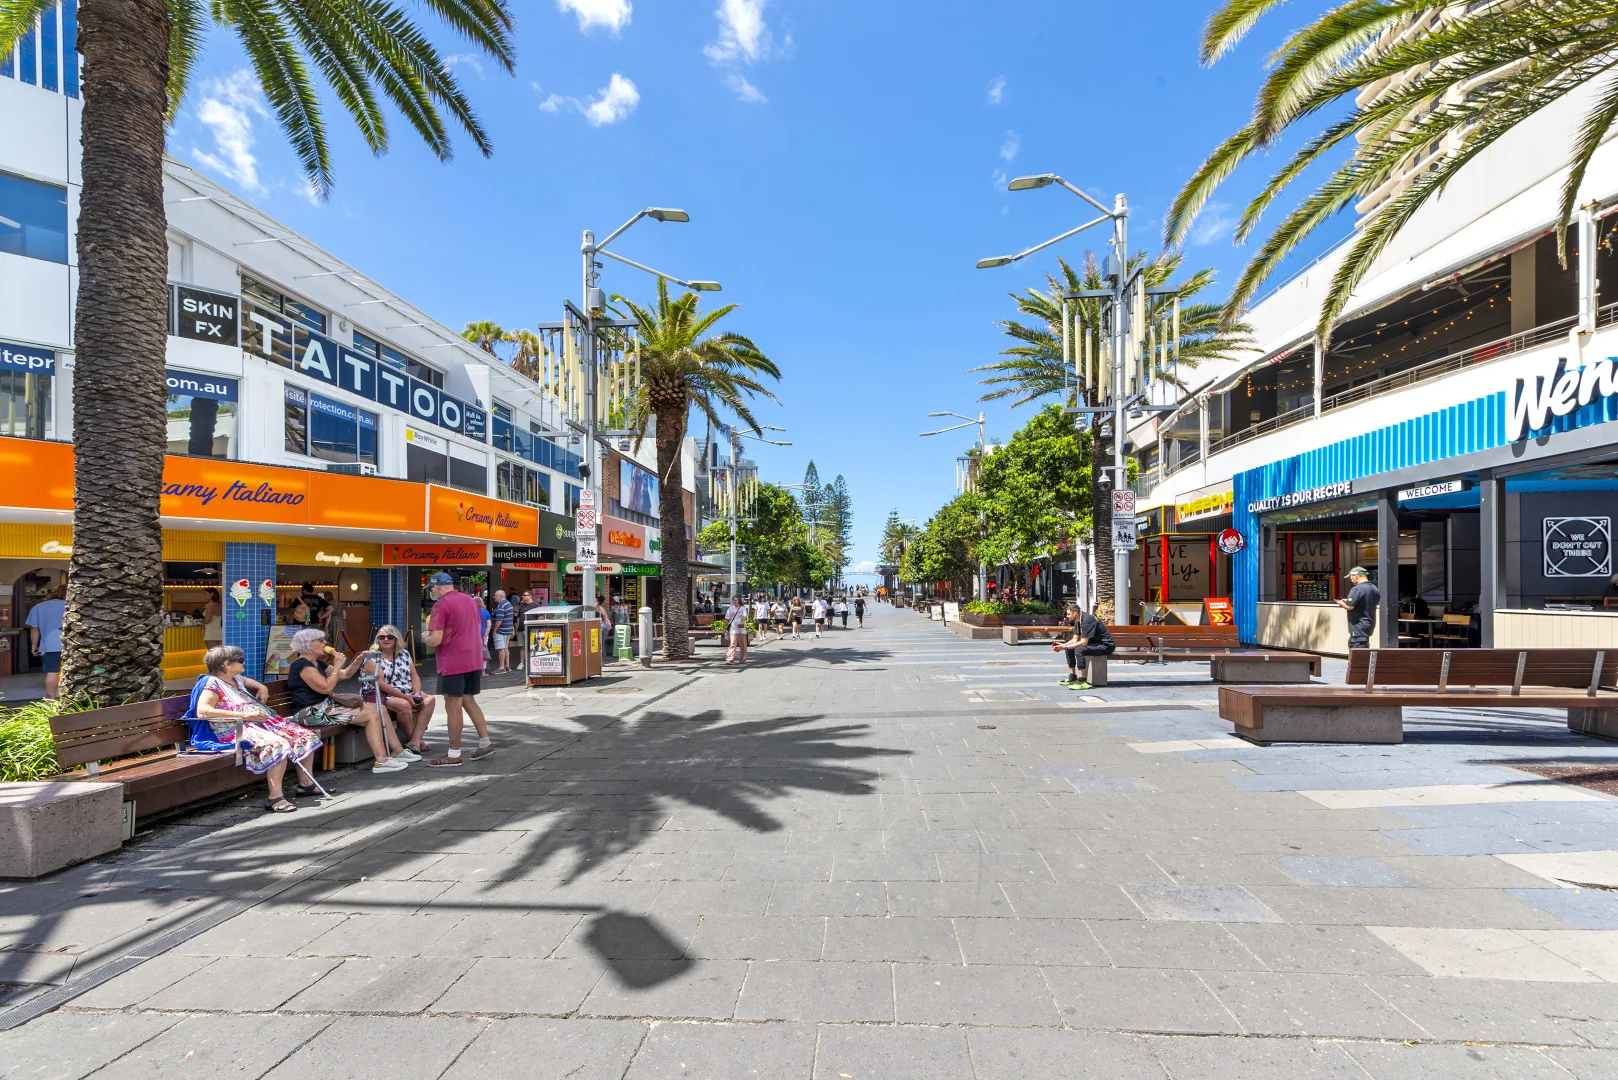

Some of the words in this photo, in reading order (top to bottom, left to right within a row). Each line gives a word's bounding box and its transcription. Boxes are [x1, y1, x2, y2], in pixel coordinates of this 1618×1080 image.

[183, 298, 233, 320] SKIN
[195, 320, 222, 338] FX
[0, 349, 56, 369] tepr
[250, 311, 461, 428] TATTOO
[222, 480, 305, 505] Italiano
[1248, 496, 1280, 513] QUALITY
[1282, 494, 1291, 506] IS
[1292, 489, 1312, 505] OUR
[1314, 481, 1351, 500] RECIPE
[1406, 483, 1453, 498] WELCOME
[1177, 491, 1233, 516] TIMEZONE
[466, 506, 494, 530] Creamy
[494, 511, 520, 529] Italiano
[562, 529, 576, 542] sung
[1570, 533, 1585, 541] WE
[1293, 542, 1328, 557] OVE
[1552, 542, 1582, 550] DON'T
[1582, 541, 1602, 549] CUT
[1563, 549, 1592, 557] THESE
[402, 547, 440, 563] Creamy
[442, 547, 480, 560] Italiano
[528, 549, 543, 559] hut
[623, 564, 656, 575] uikstop
